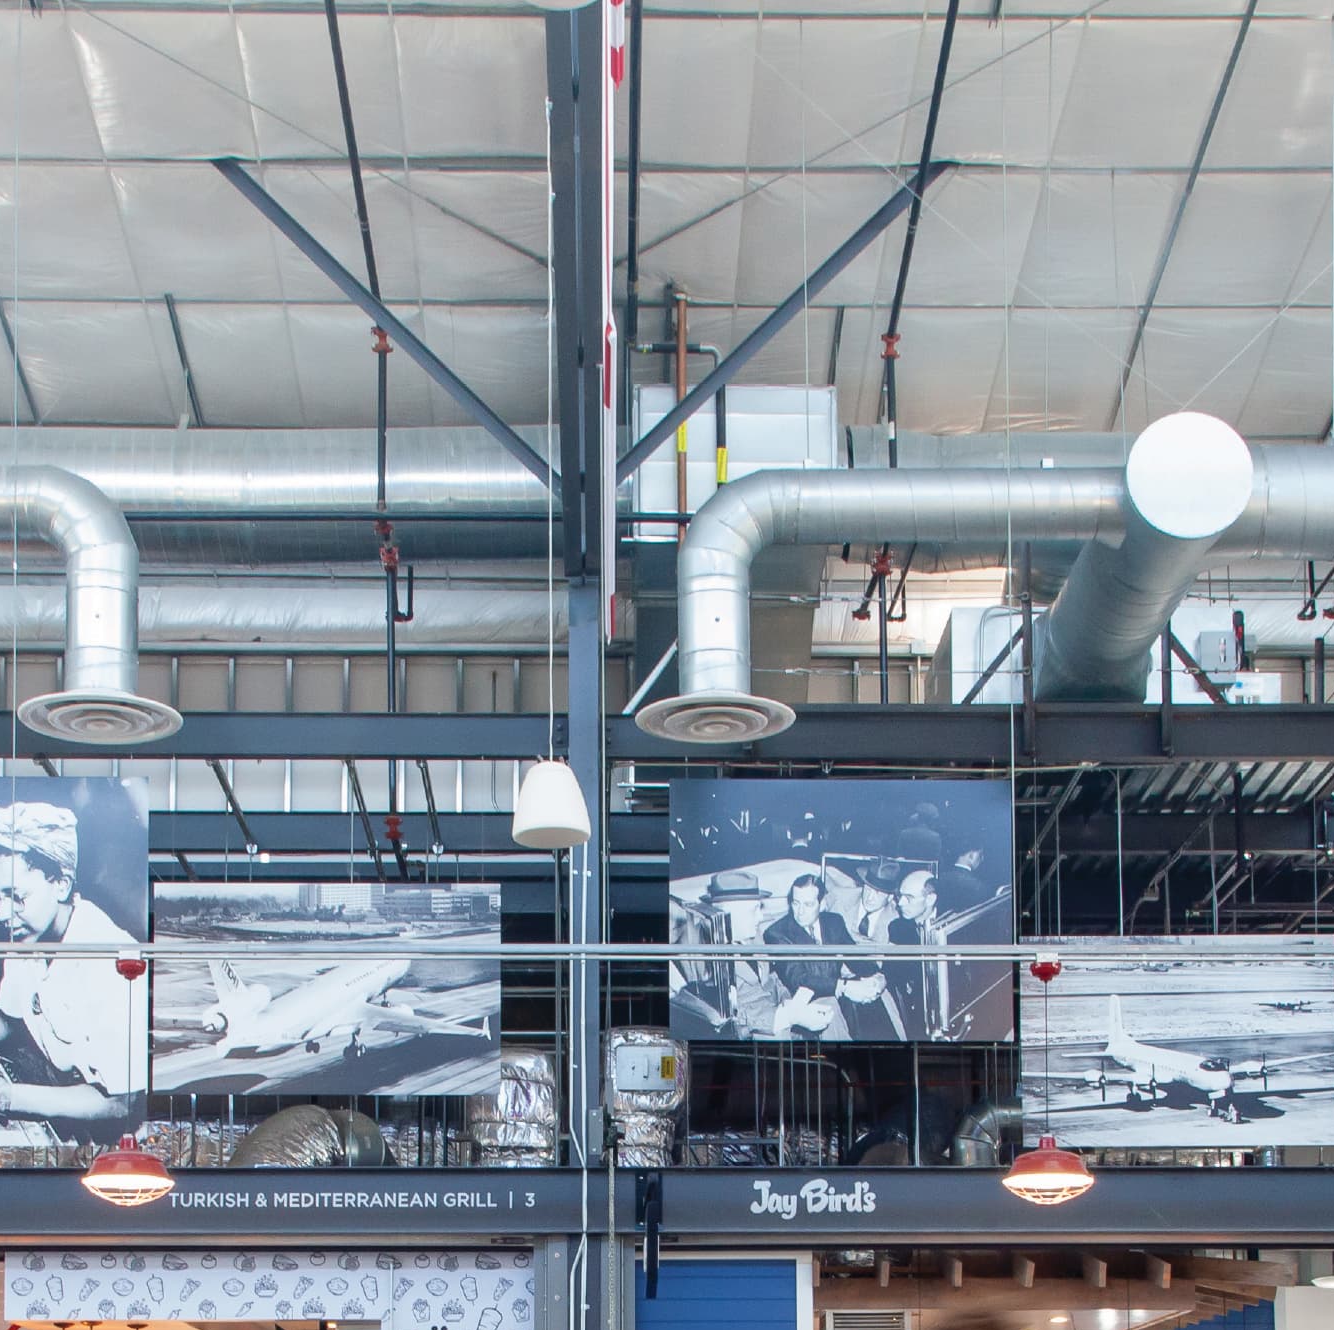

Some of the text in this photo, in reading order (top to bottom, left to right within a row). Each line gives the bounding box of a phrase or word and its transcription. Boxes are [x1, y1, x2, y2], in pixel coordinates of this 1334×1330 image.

[168, 1193, 250, 1208] TURKISH
[254, 1193, 267, 1208] &
[273, 1193, 439, 1208] MEDITERRANEAN
[443, 1193, 497, 1208] GRILL
[524, 1193, 536, 1208] 3
[750, 1179, 877, 1219] Jay Bird's
